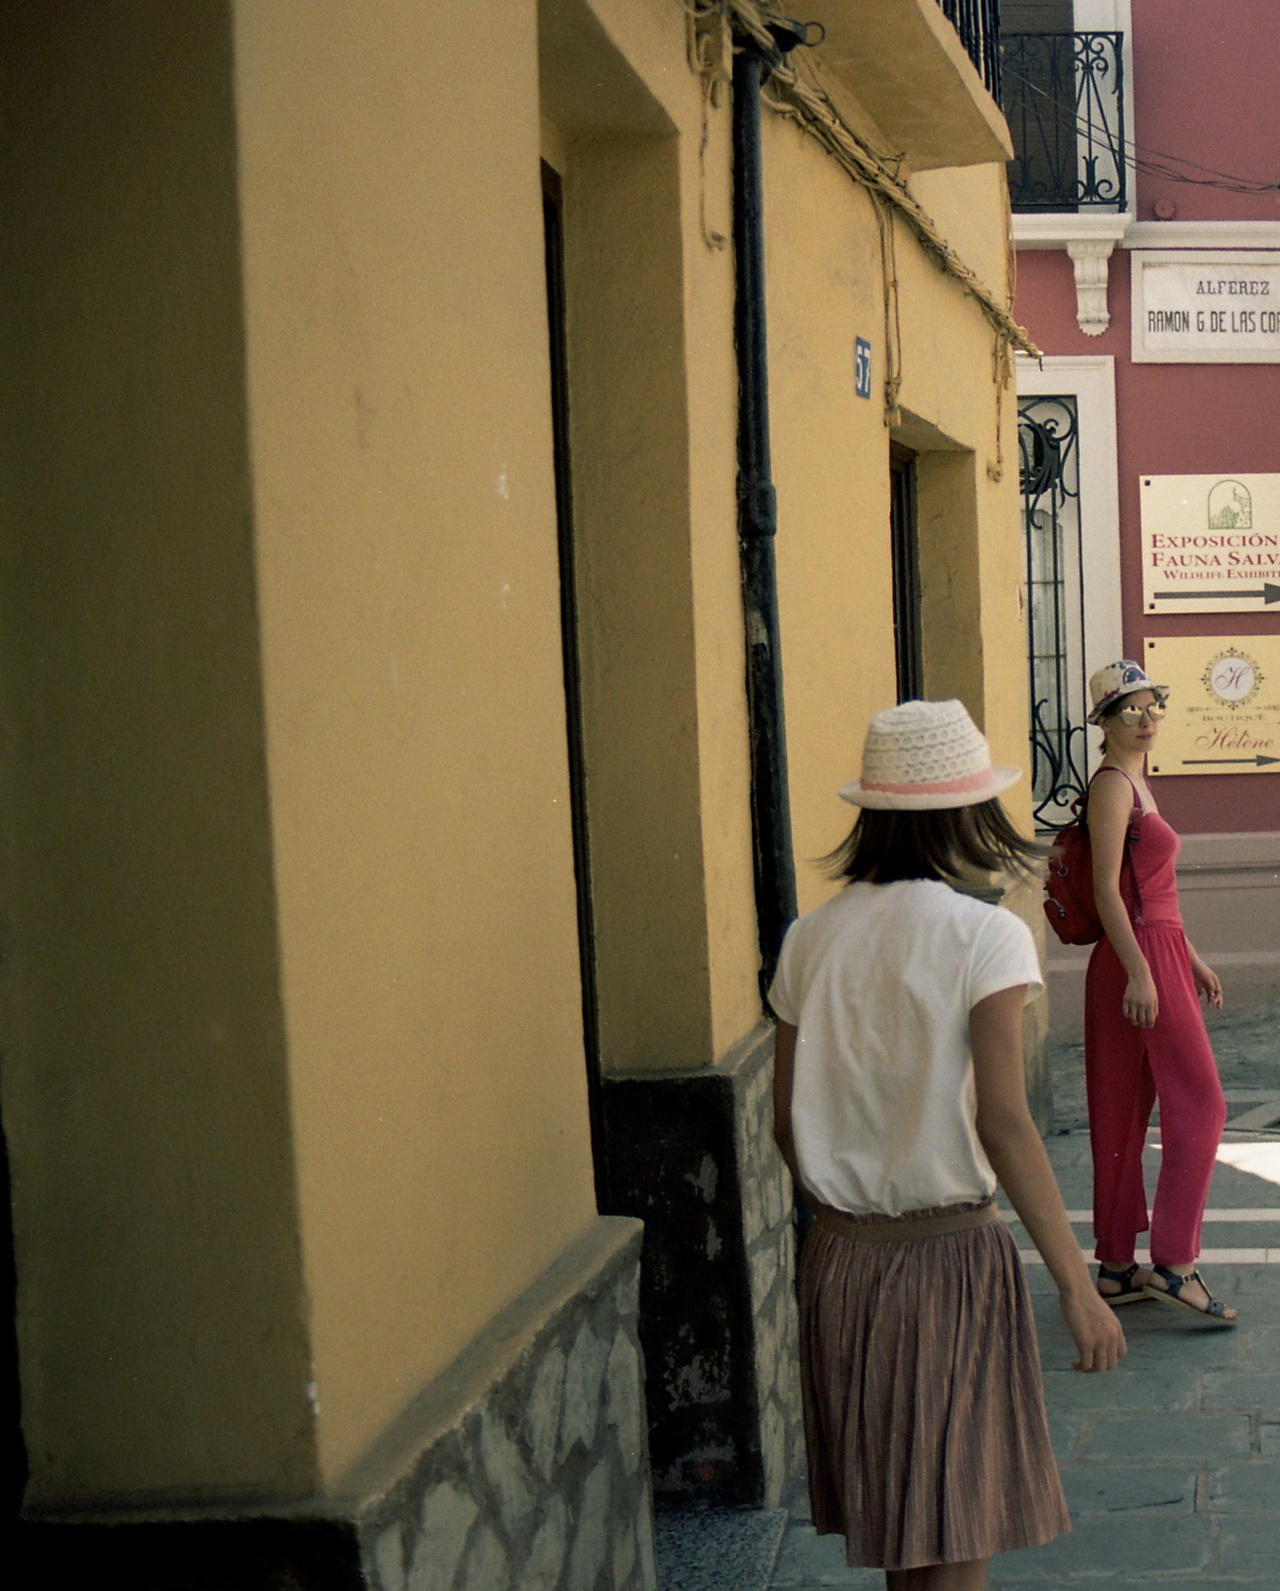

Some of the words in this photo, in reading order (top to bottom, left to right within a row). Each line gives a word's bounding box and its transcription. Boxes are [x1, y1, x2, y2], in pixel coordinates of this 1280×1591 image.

[1148, 310, 1190, 333] RAMON
[1196, 310, 1209, 333] G.
[1210, 311, 1227, 333] DE
[1231, 311, 1257, 334] LAS
[856, 344, 871, 393] 57
[1151, 533, 1278, 548] EXPOSICIÓN
[1151, 552, 1222, 567] FAUNA
[1163, 570, 1223, 579] WILDLIFE
